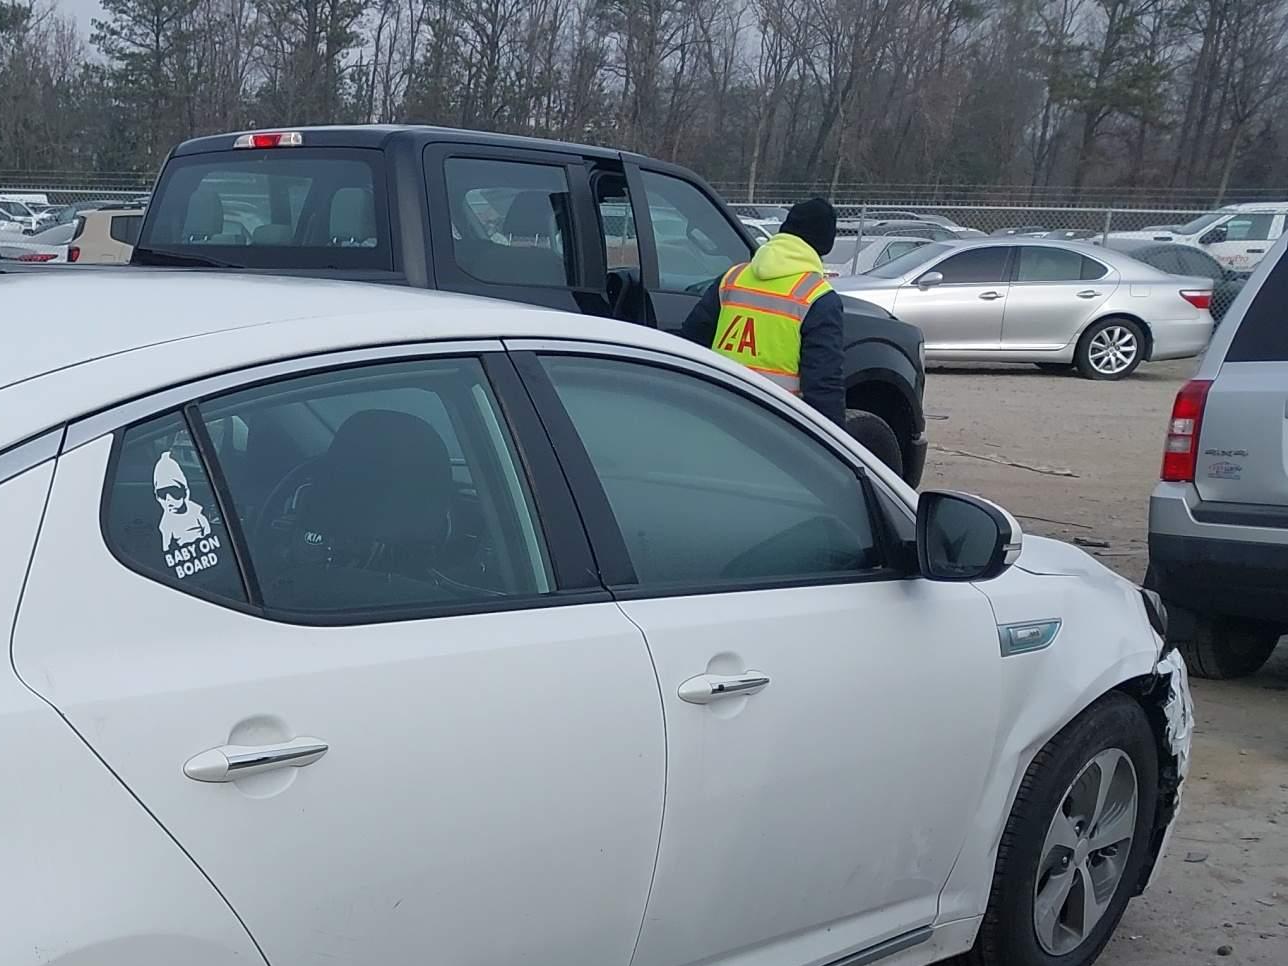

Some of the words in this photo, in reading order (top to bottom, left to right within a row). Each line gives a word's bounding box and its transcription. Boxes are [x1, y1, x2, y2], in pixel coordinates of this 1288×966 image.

[165, 543, 197, 567] BABY
[199, 535, 221, 553] ON
[175, 552, 218, 579] BOARD
